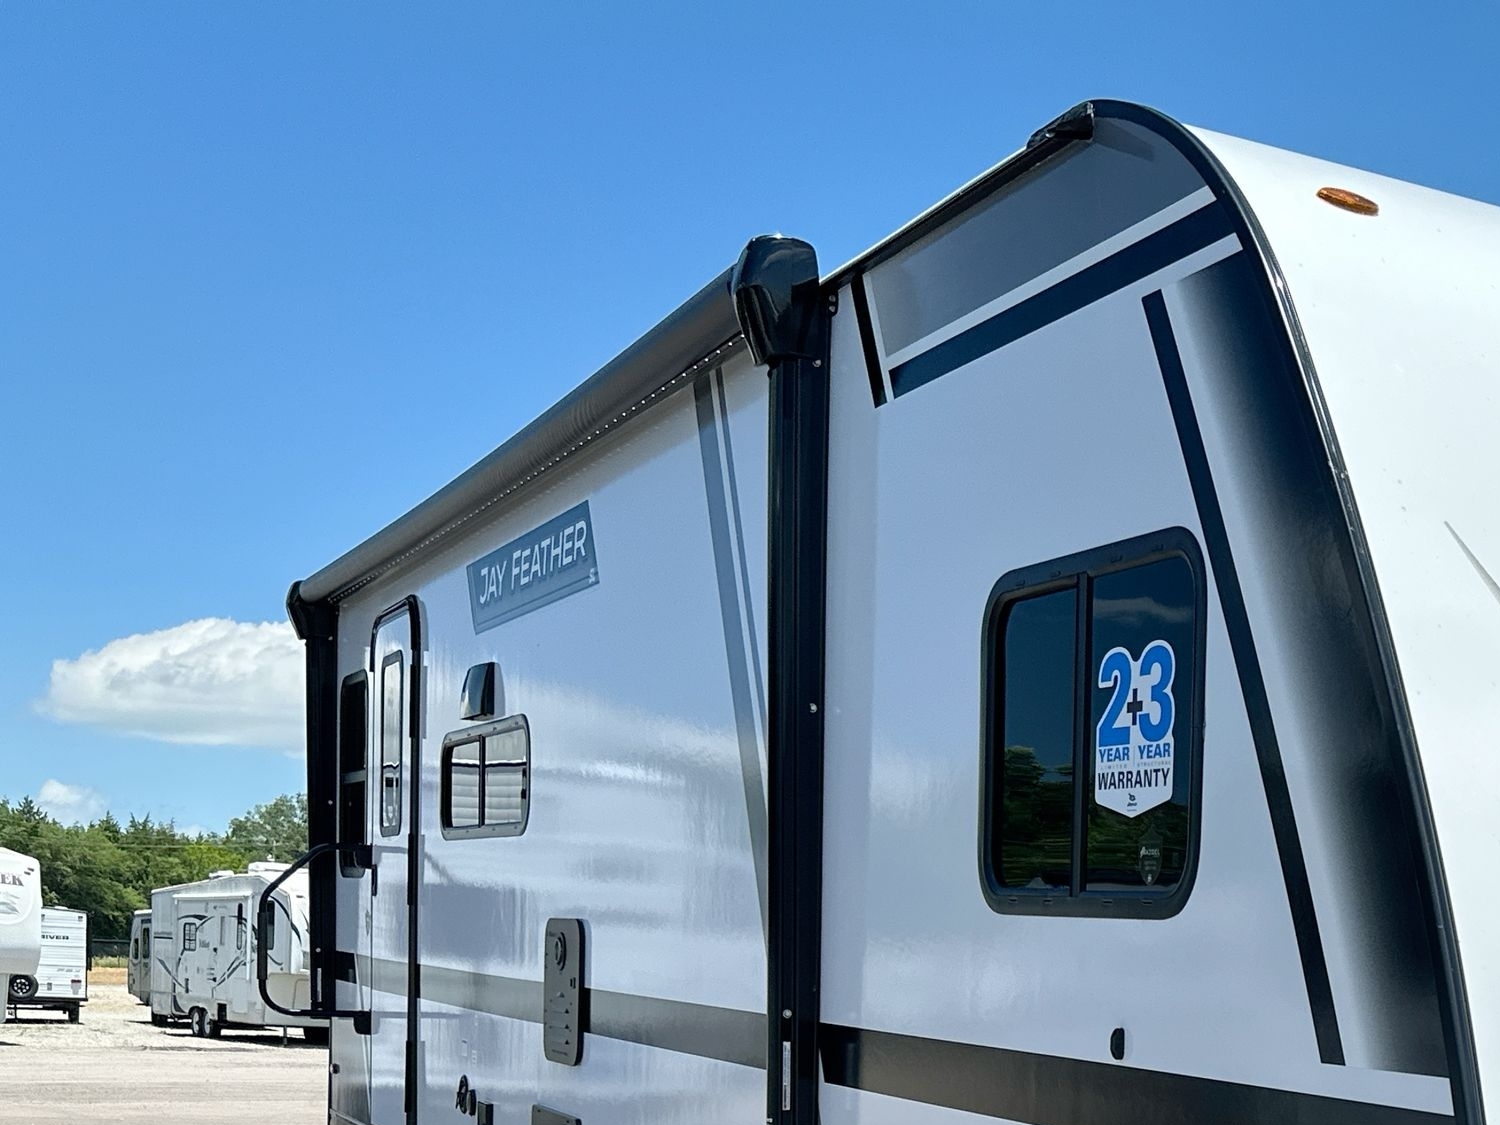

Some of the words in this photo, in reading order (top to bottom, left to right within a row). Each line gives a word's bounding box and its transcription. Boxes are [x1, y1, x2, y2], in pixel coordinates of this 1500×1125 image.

[479, 560, 507, 604] JAY
[511, 520, 588, 590] FEATHER
[1098, 746, 1130, 763] YEAR
[1137, 742, 1171, 759] YEAR
[1098, 768, 1170, 791] WARRANTY
